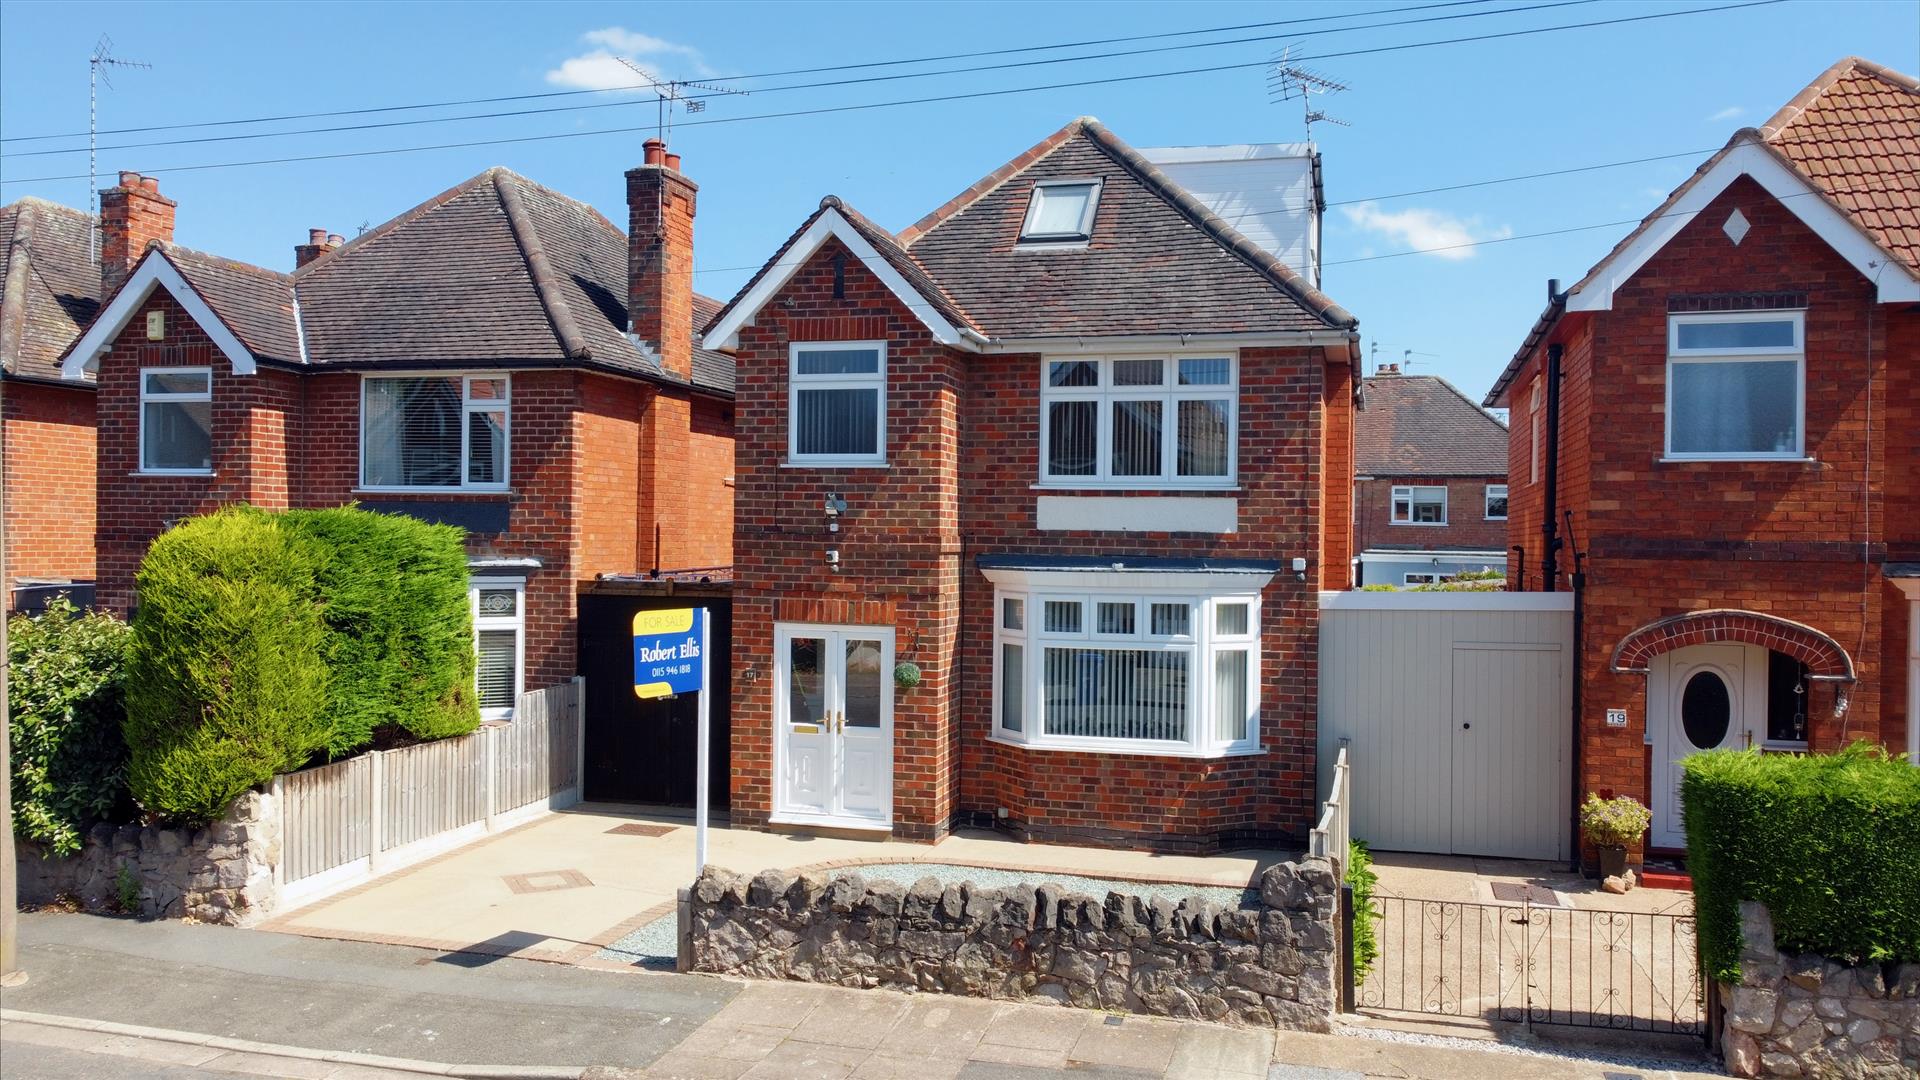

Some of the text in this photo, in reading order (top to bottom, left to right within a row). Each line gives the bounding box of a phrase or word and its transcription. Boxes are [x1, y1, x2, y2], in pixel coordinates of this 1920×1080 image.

[643, 614, 685, 629] FOR SALE
[640, 637, 700, 663] Robert Ellis
[651, 663, 691, 678] 0115 946 1818
[1609, 713, 1625, 723] 19
